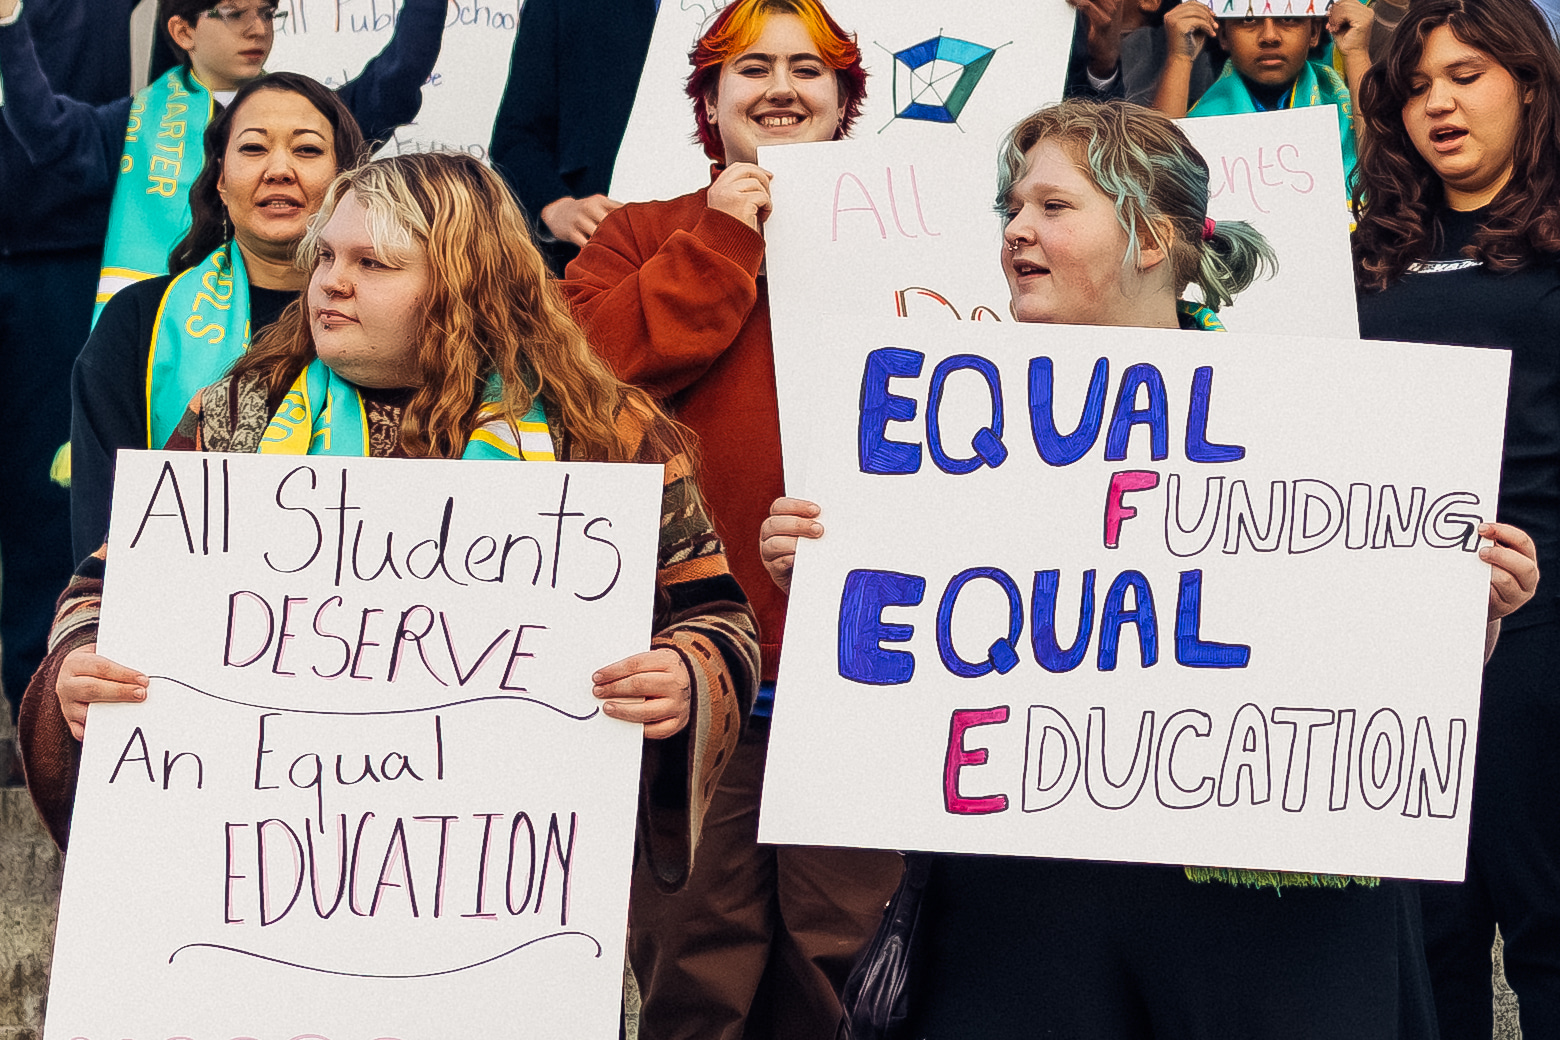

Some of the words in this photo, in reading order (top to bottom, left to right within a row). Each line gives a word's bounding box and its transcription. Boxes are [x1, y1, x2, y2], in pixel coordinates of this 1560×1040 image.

[831, 165, 941, 241] All
[857, 347, 1246, 476] EQUAL
[130, 458, 230, 556] All
[263, 465, 622, 602] Students
[1104, 470, 1484, 557] FUNDING
[223, 591, 551, 693] DESERVE
[838, 566, 1251, 686] EQUAL
[109, 726, 203, 790] An
[254, 712, 443, 835] Equal
[944, 702, 1468, 818] EDUCATION
[223, 811, 580, 927] EDUCATION
